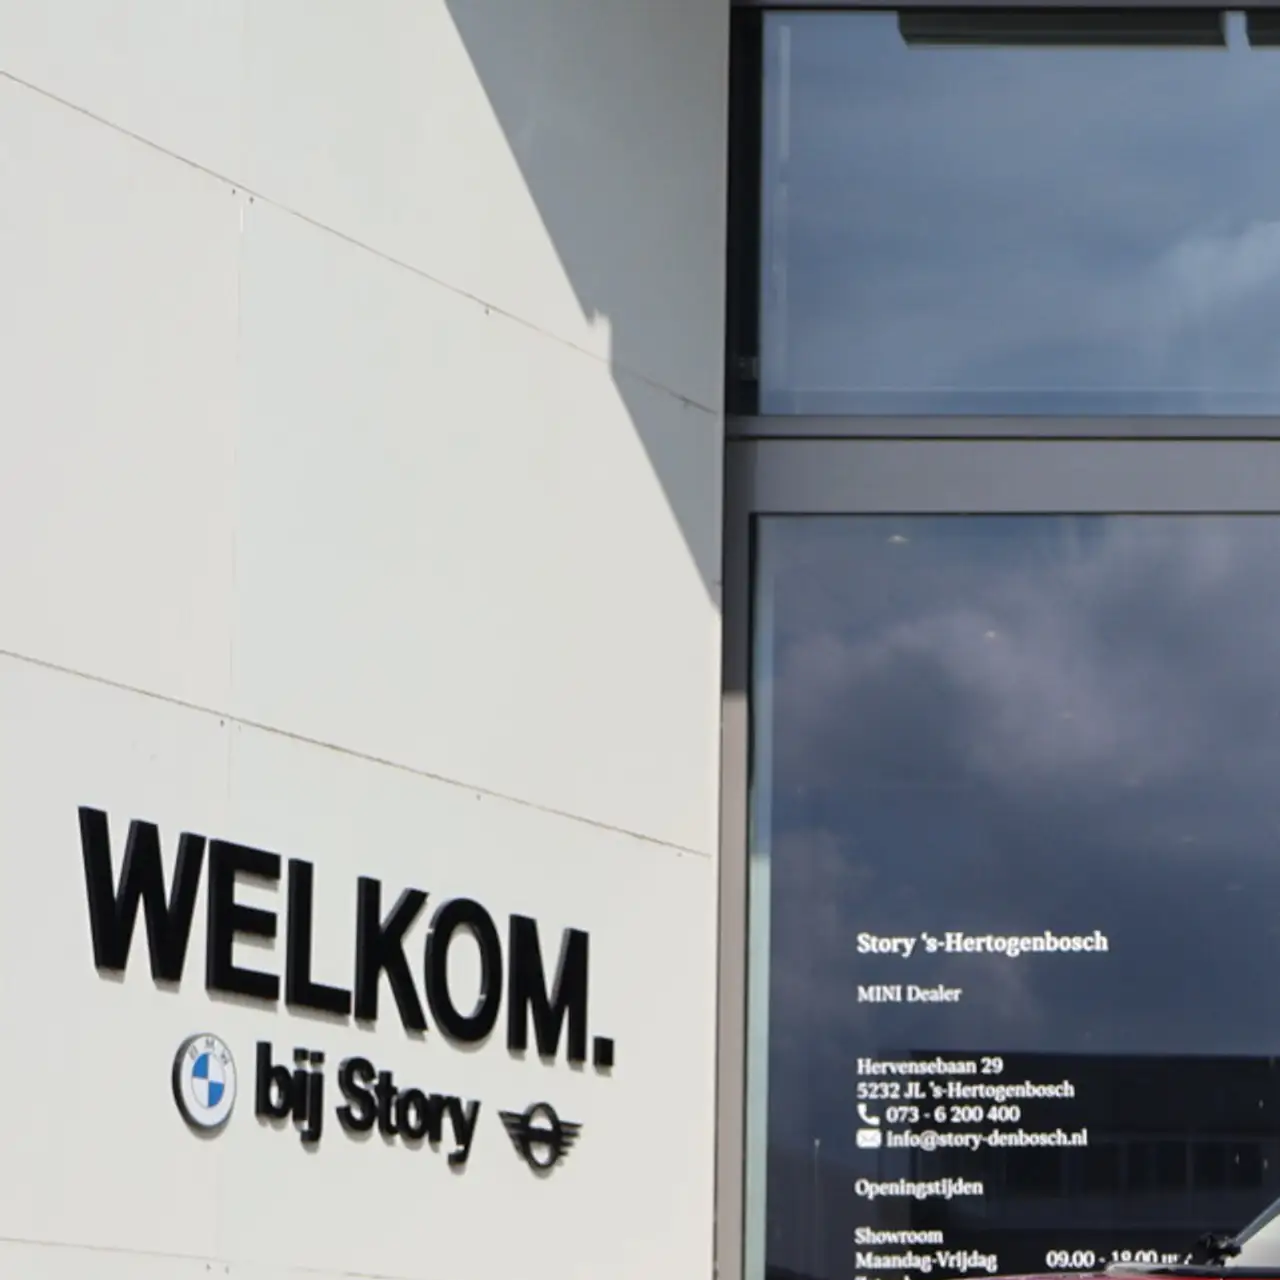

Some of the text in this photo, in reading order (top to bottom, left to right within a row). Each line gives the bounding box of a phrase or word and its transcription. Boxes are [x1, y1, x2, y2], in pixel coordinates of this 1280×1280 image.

[78, 806, 614, 1067] WELKOM.
[856, 932, 917, 958] Story
[857, 983, 963, 1003] MINI Dealer
[857, 1056, 1004, 1076] Hervensebaan 29
[857, 1081, 901, 1100] 5232
[903, 1081, 926, 1099] JL
[255, 1041, 482, 1166] bij Story
[885, 1105, 920, 1123] 073
[934, 1105, 947, 1123] 6
[950, 1105, 984, 1123] 200
[986, 1105, 1021, 1122] 400
[886, 1128, 1088, 1151] info@story-denbosch.nl
[854, 1177, 984, 1200] Openingstijden
[854, 1226, 944, 1245] Showroom
[855, 1249, 998, 1273] Maandag-Vrijdag
[1045, 1250, 1096, 1268] 09.00
